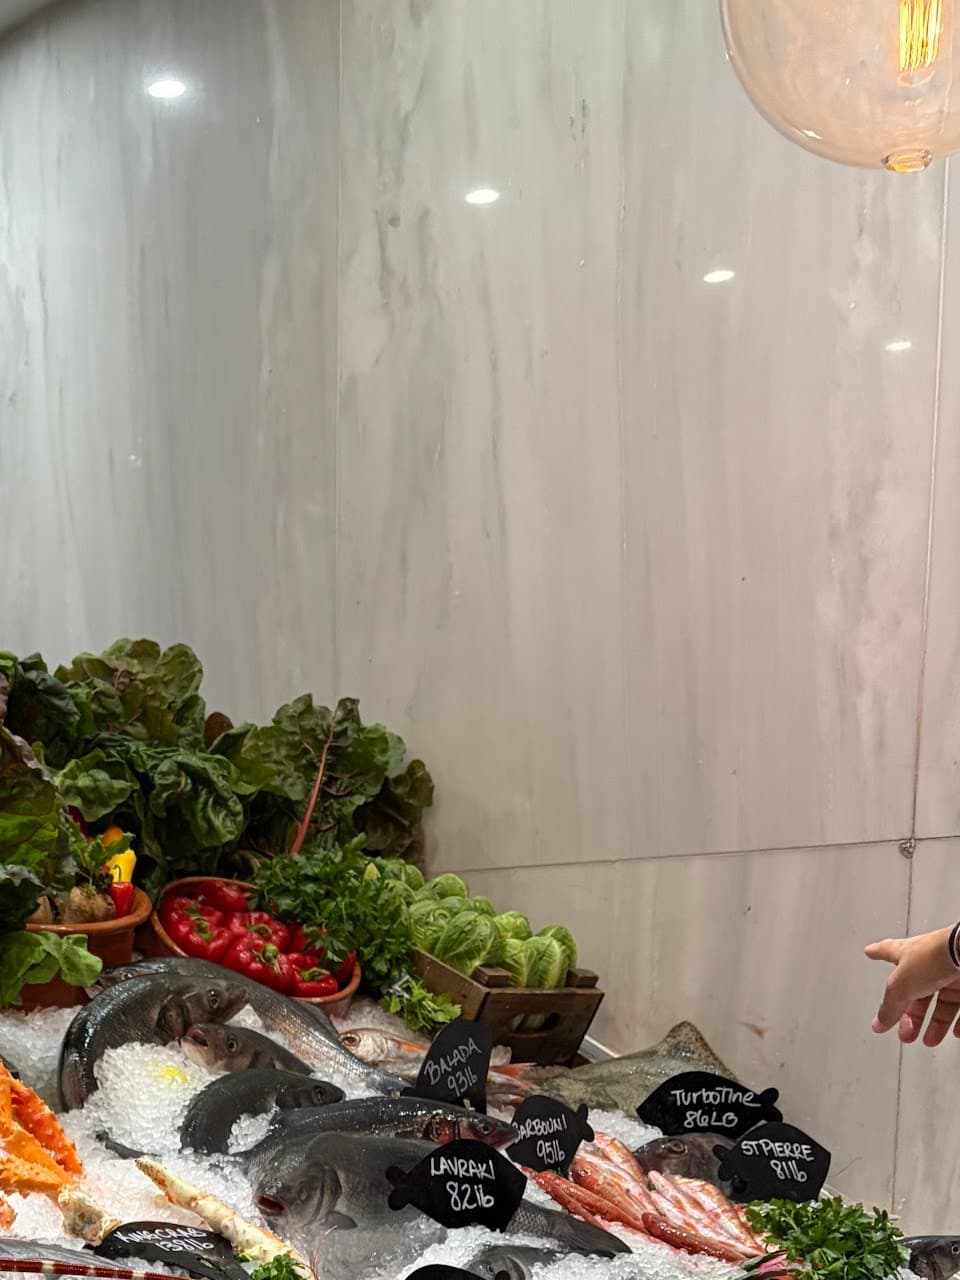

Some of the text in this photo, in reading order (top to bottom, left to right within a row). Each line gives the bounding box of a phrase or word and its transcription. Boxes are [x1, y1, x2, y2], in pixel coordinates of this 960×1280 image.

[424, 1038, 482, 1086] BALADA
[536, 1139, 566, 1165] 95lb
[430, 1156, 496, 1180] LAVRAKI
[445, 1181, 495, 1211] 82lb
